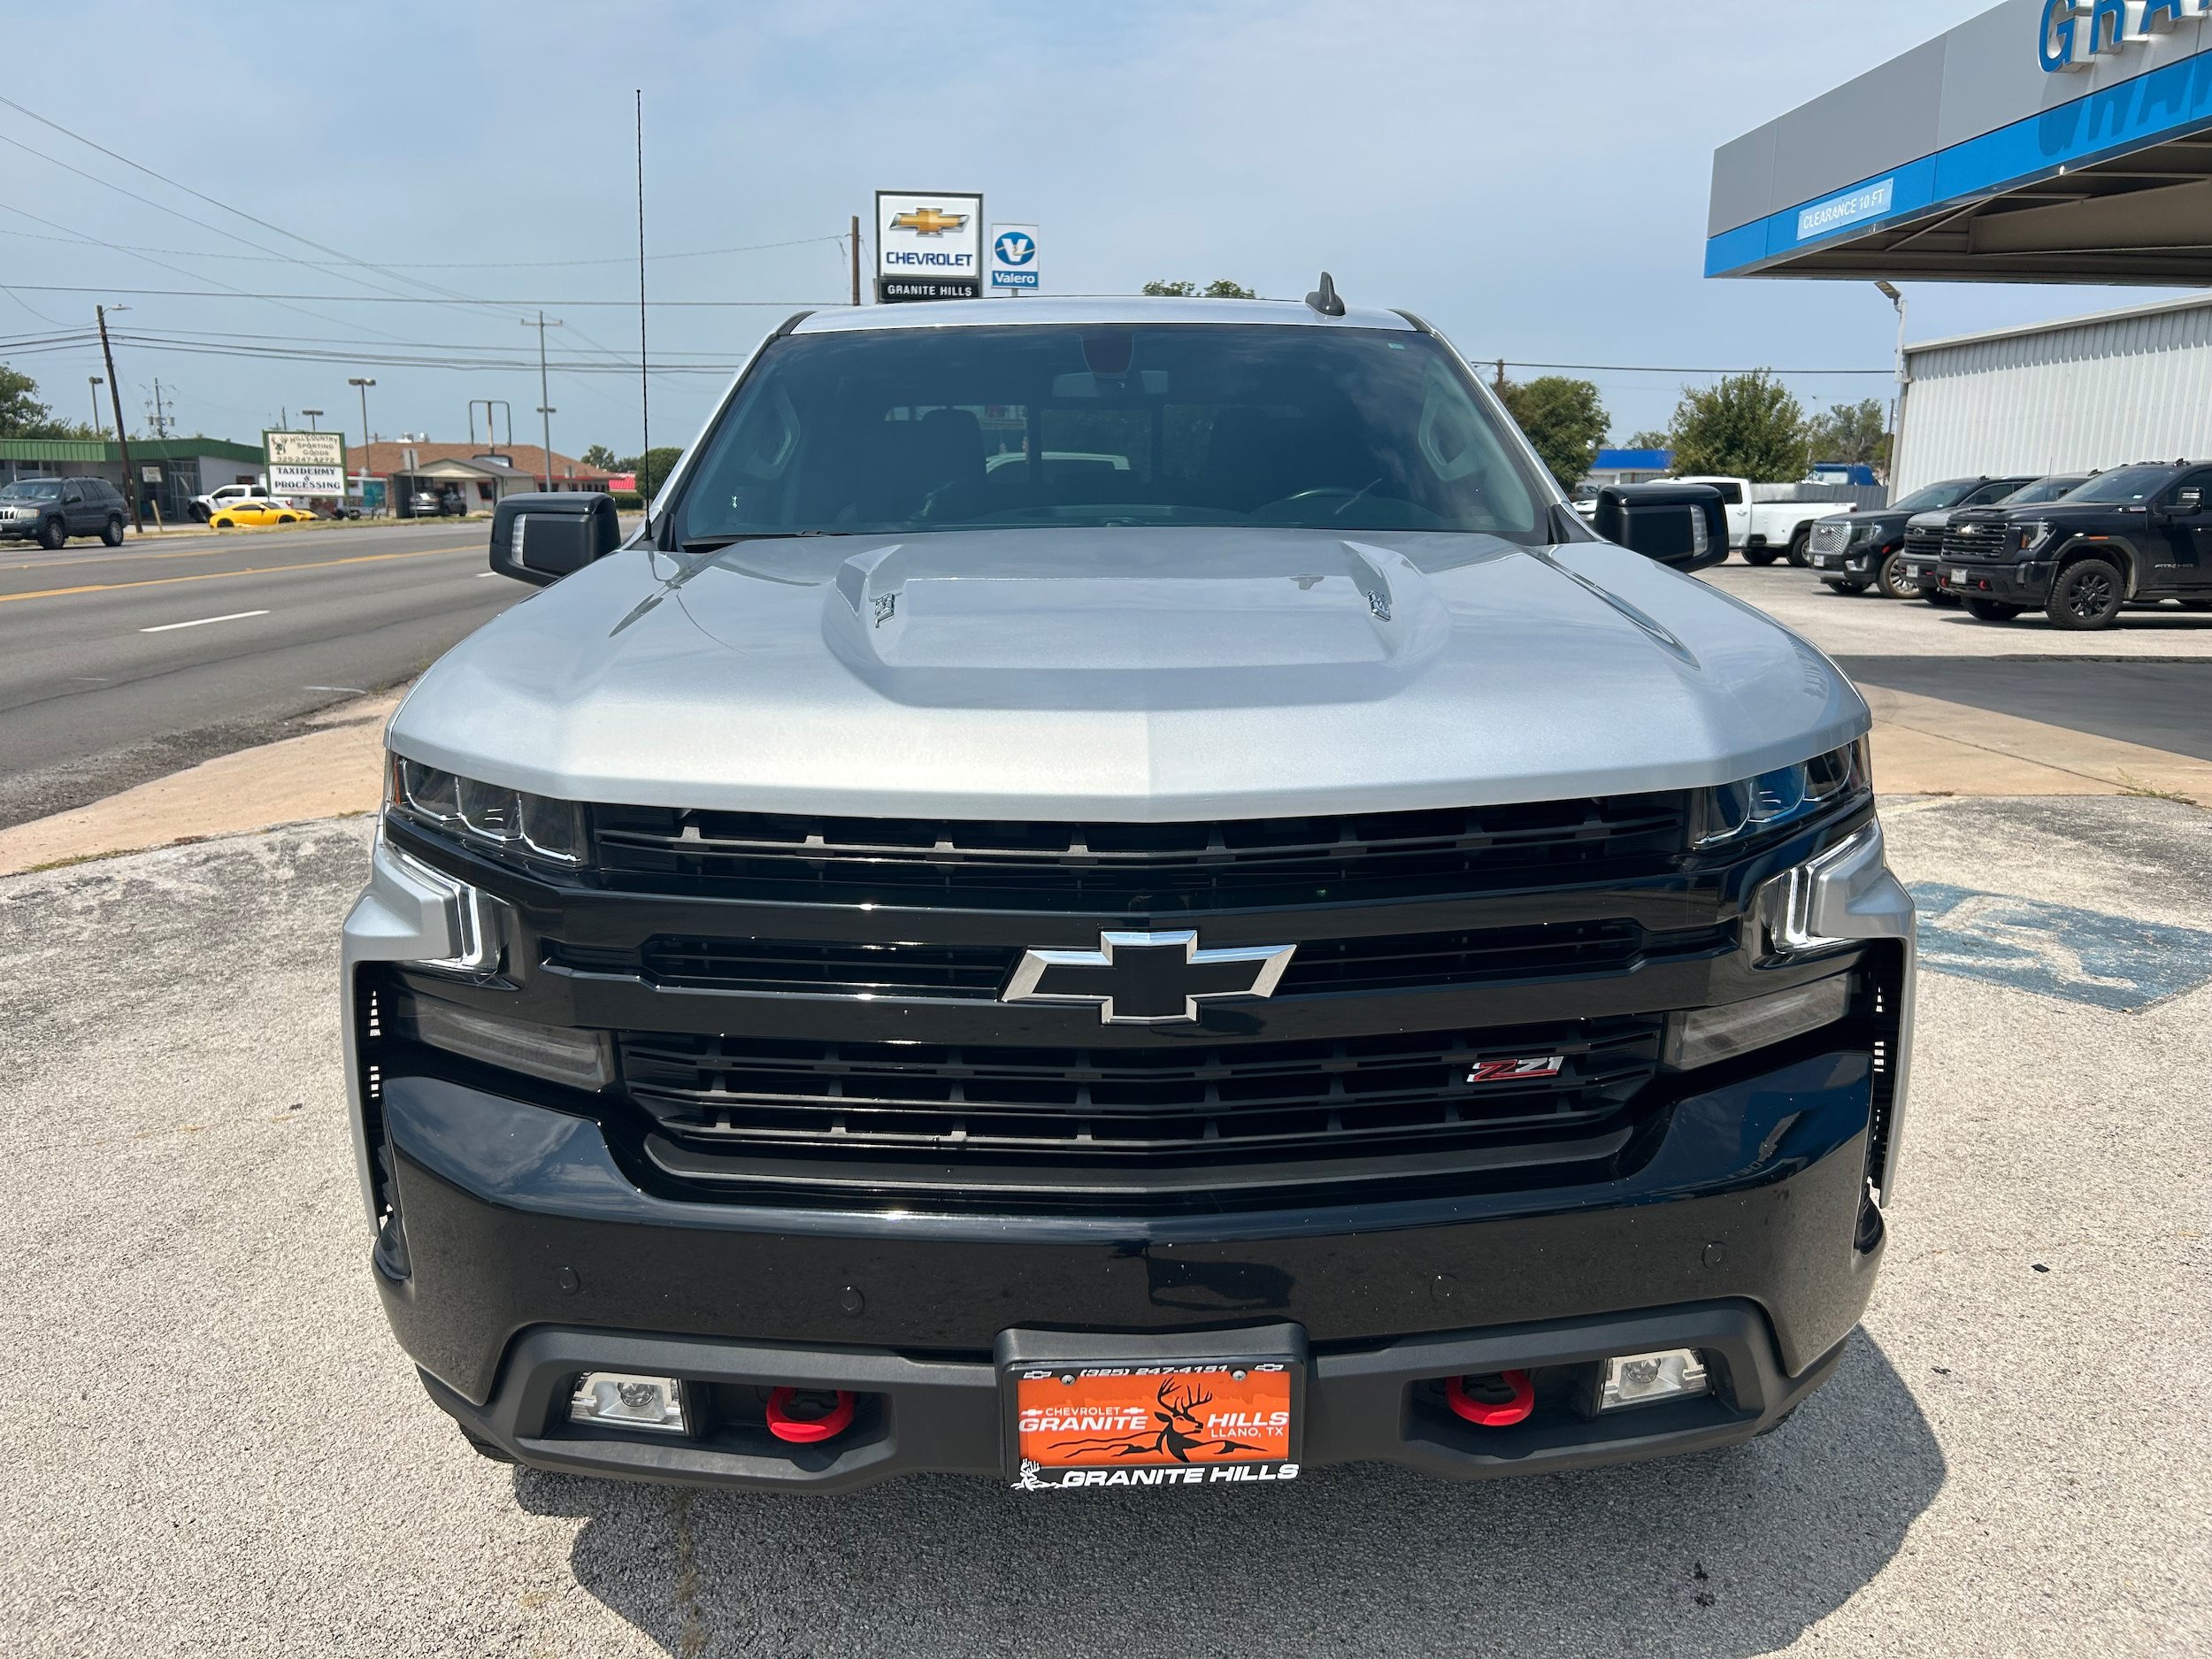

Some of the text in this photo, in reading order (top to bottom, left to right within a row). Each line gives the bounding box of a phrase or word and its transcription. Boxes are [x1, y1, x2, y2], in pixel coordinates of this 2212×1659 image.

[1803, 188, 1885, 229] CLEARANCE 10 FT
[886, 251, 973, 266] CHEVROLET
[994, 272, 1036, 284] Valero
[887, 284, 972, 297] GRANITE HILLS
[290, 434, 338, 444] HILL COUNTRY
[276, 466, 335, 475] TAXIDERMY
[274, 480, 341, 489] PROCESSING
[1466, 1056, 1564, 1082] Z71
[1045, 1406, 1120, 1417] CHEVROLET
[1018, 1411, 1289, 1432] GRANITE HILLS
[1210, 1426, 1284, 1438] LLANO, TX
[1062, 1463, 1300, 1487] GRANITE HILLS
